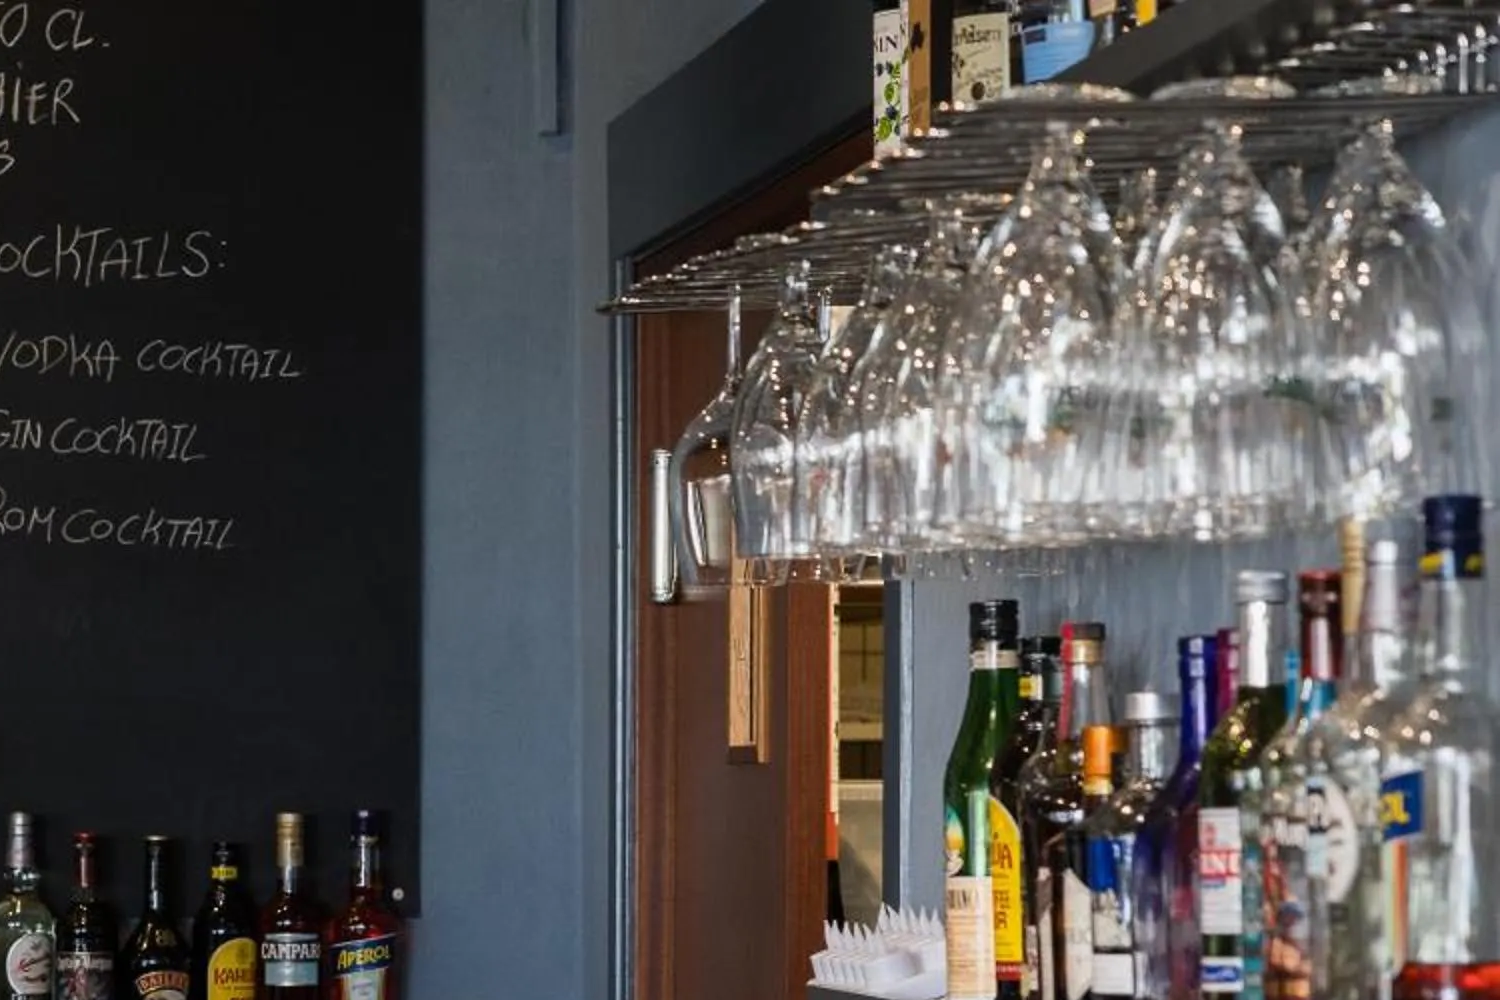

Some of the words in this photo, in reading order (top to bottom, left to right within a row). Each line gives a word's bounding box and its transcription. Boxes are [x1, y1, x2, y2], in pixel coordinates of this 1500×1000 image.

[137, 340, 301, 380] COCKTAIL
[50, 417, 207, 462] COCKTAIL
[62, 509, 237, 550] COCKTAIL
